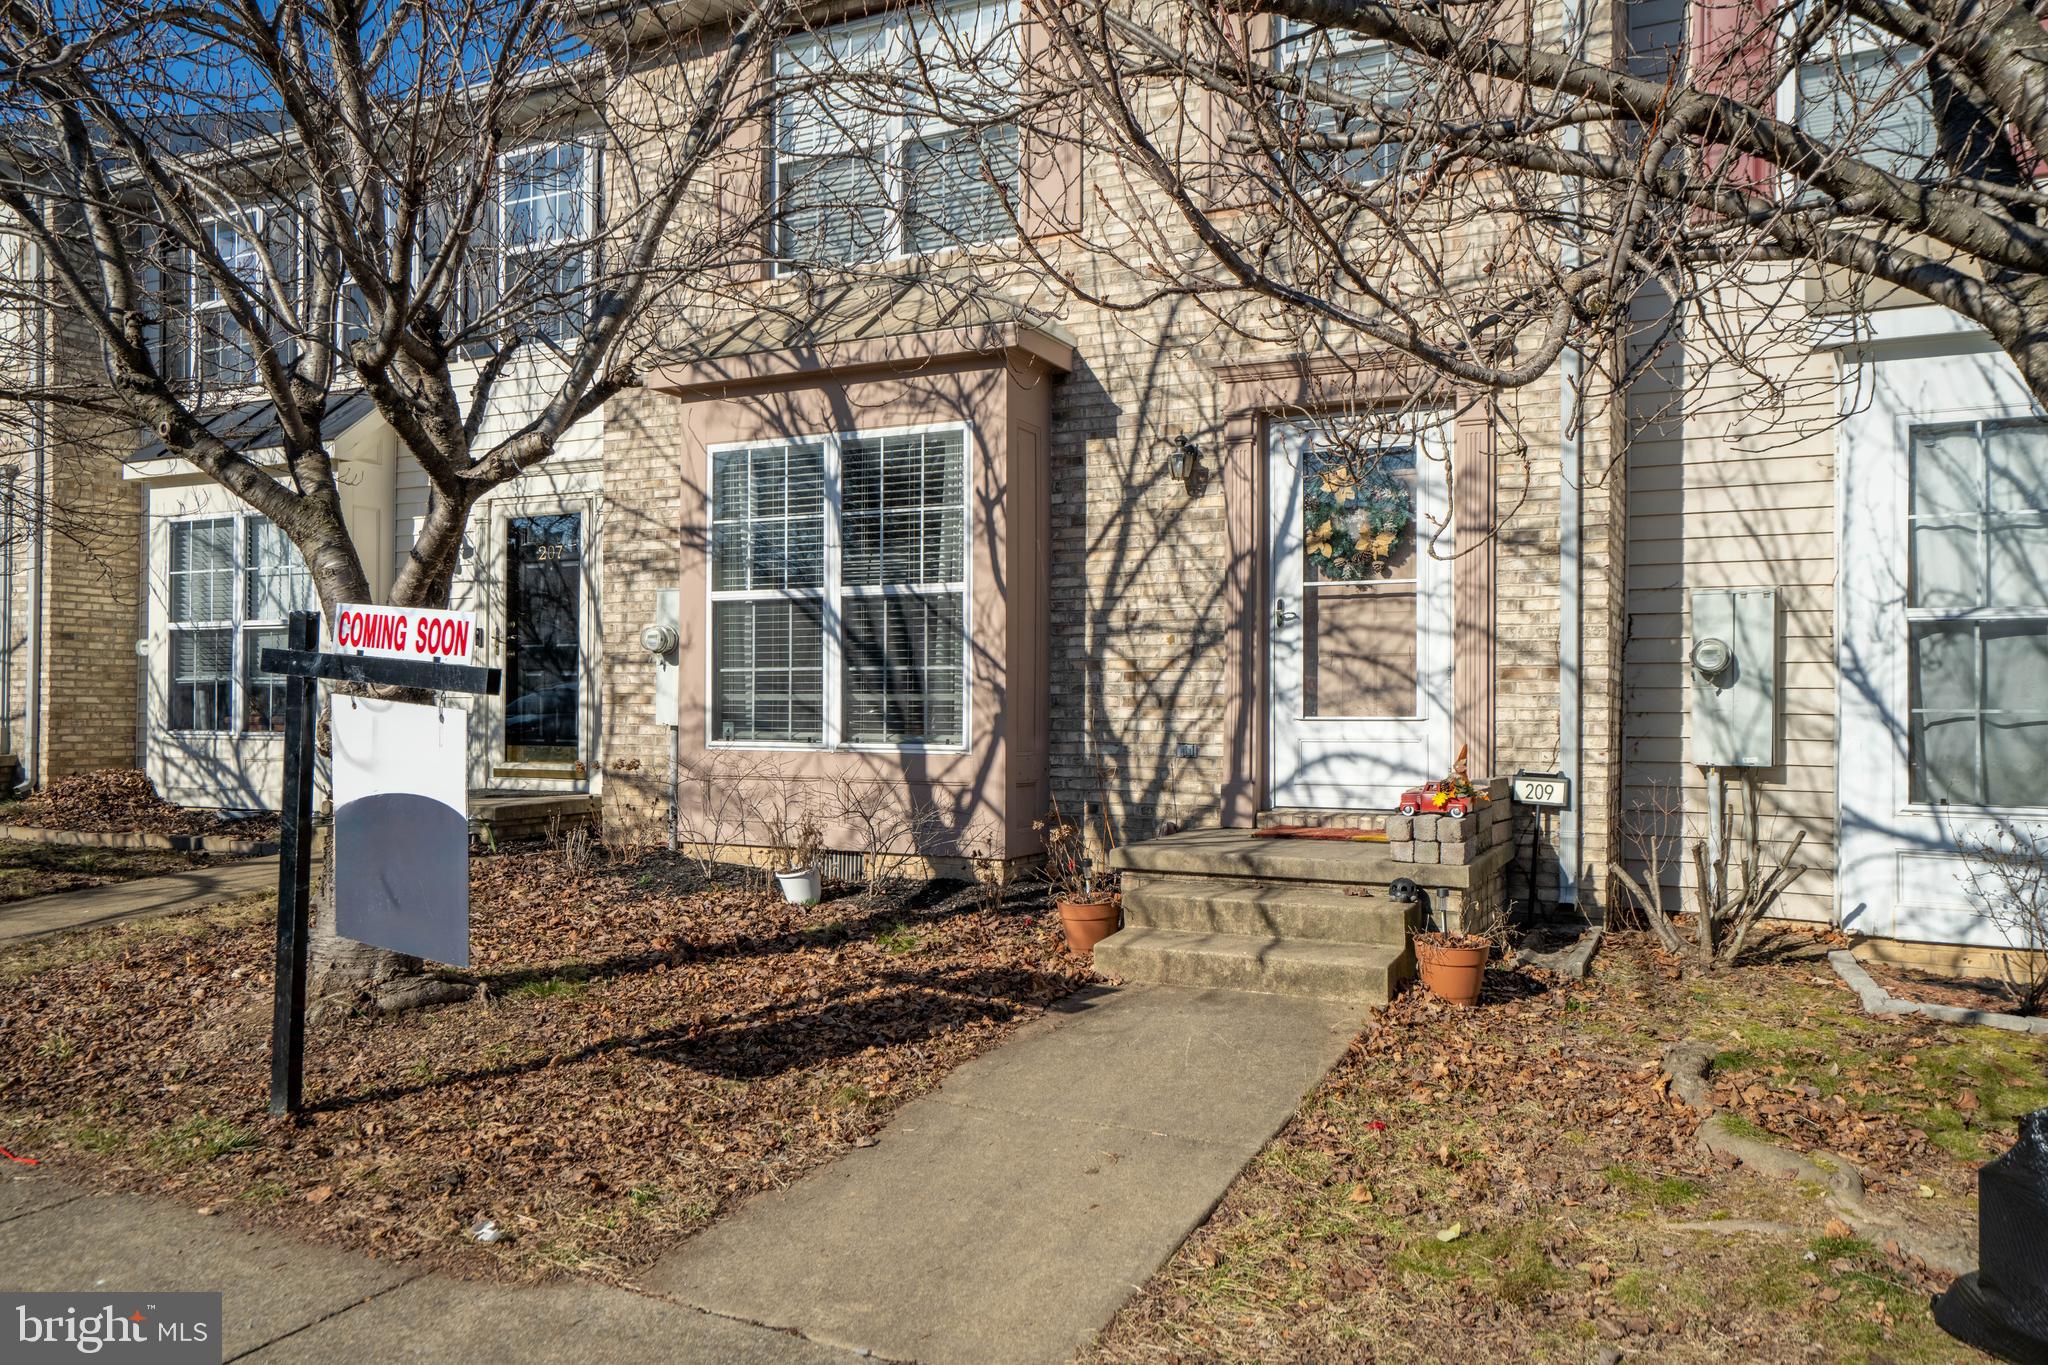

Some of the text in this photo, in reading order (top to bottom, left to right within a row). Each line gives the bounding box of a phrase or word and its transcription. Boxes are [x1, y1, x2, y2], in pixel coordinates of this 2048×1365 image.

[538, 545, 563, 561] 207
[338, 611, 470, 656] COMING SOON
[1525, 783, 1554, 801] 209
